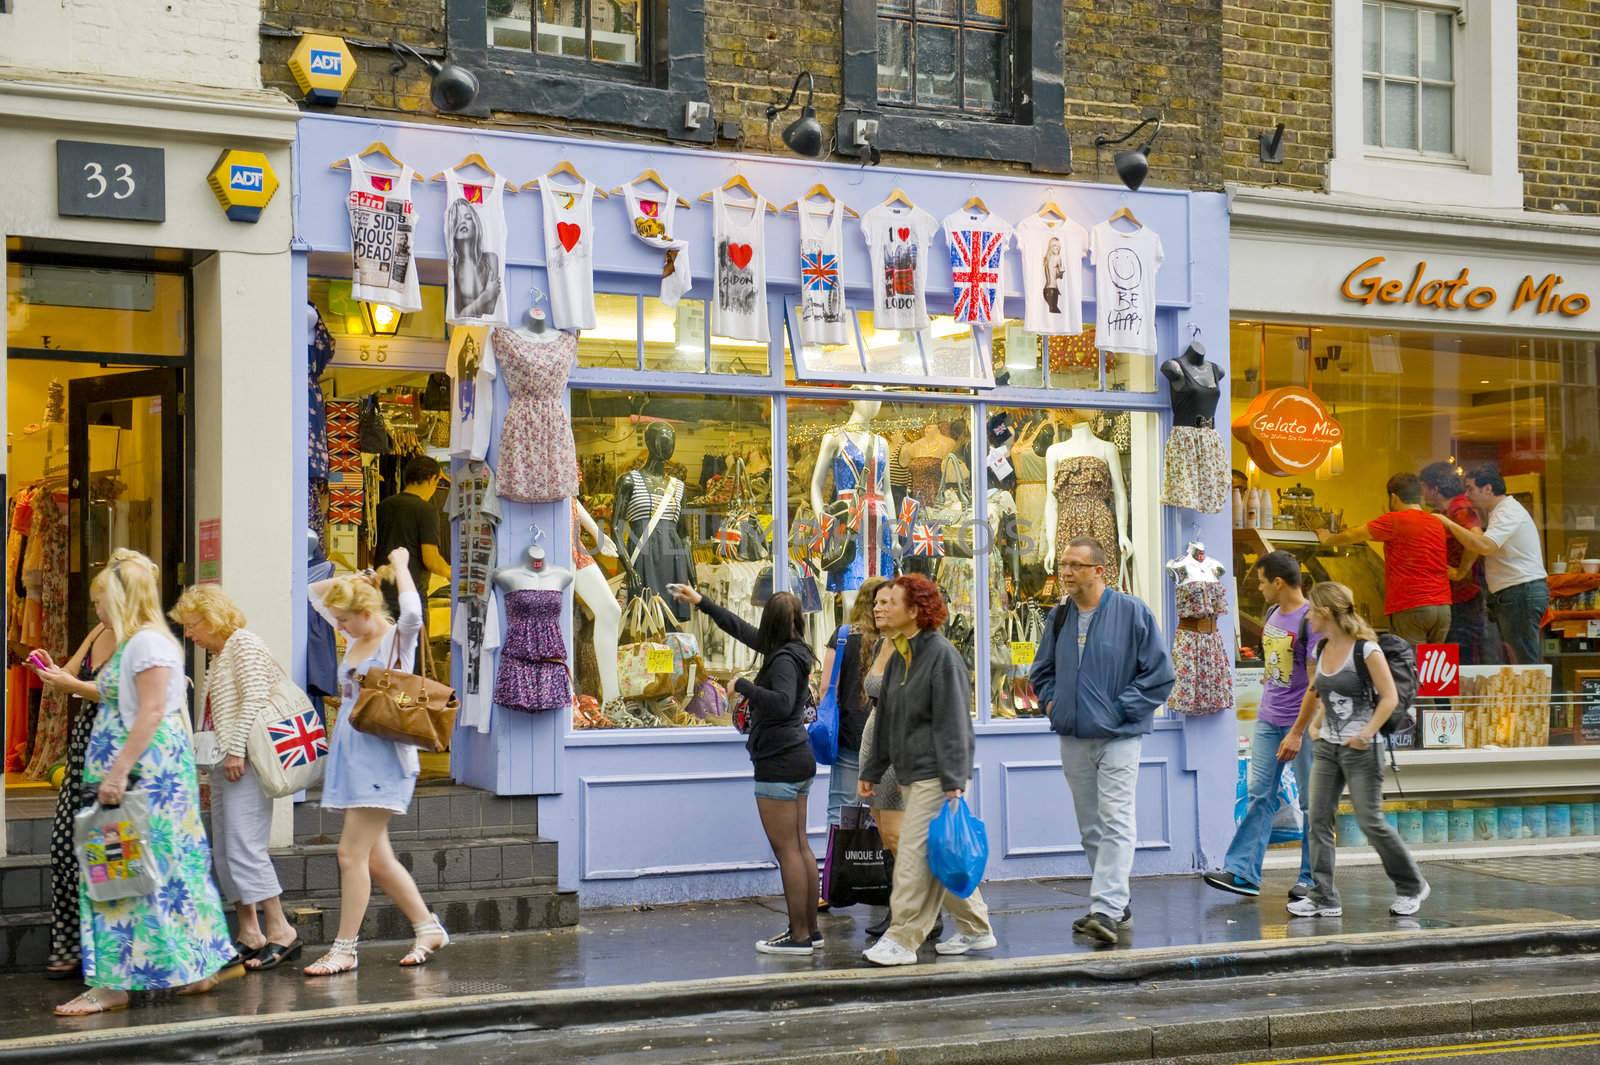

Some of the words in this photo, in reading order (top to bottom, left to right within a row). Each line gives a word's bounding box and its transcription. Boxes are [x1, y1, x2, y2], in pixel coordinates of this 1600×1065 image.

[311, 55, 342, 71] ADT
[83, 162, 136, 199] 33
[231, 170, 263, 187] ADT
[373, 214, 395, 231] SID
[358, 244, 392, 261] DEAD
[1340, 256, 1497, 310] Gelato
[1512, 273, 1591, 316] Mio
[1116, 291, 1139, 312] BE
[1253, 414, 1307, 433] Gelato
[1312, 421, 1341, 436] Mio
[1419, 649, 1457, 691] illy
[845, 850, 873, 860] UNIQUE
